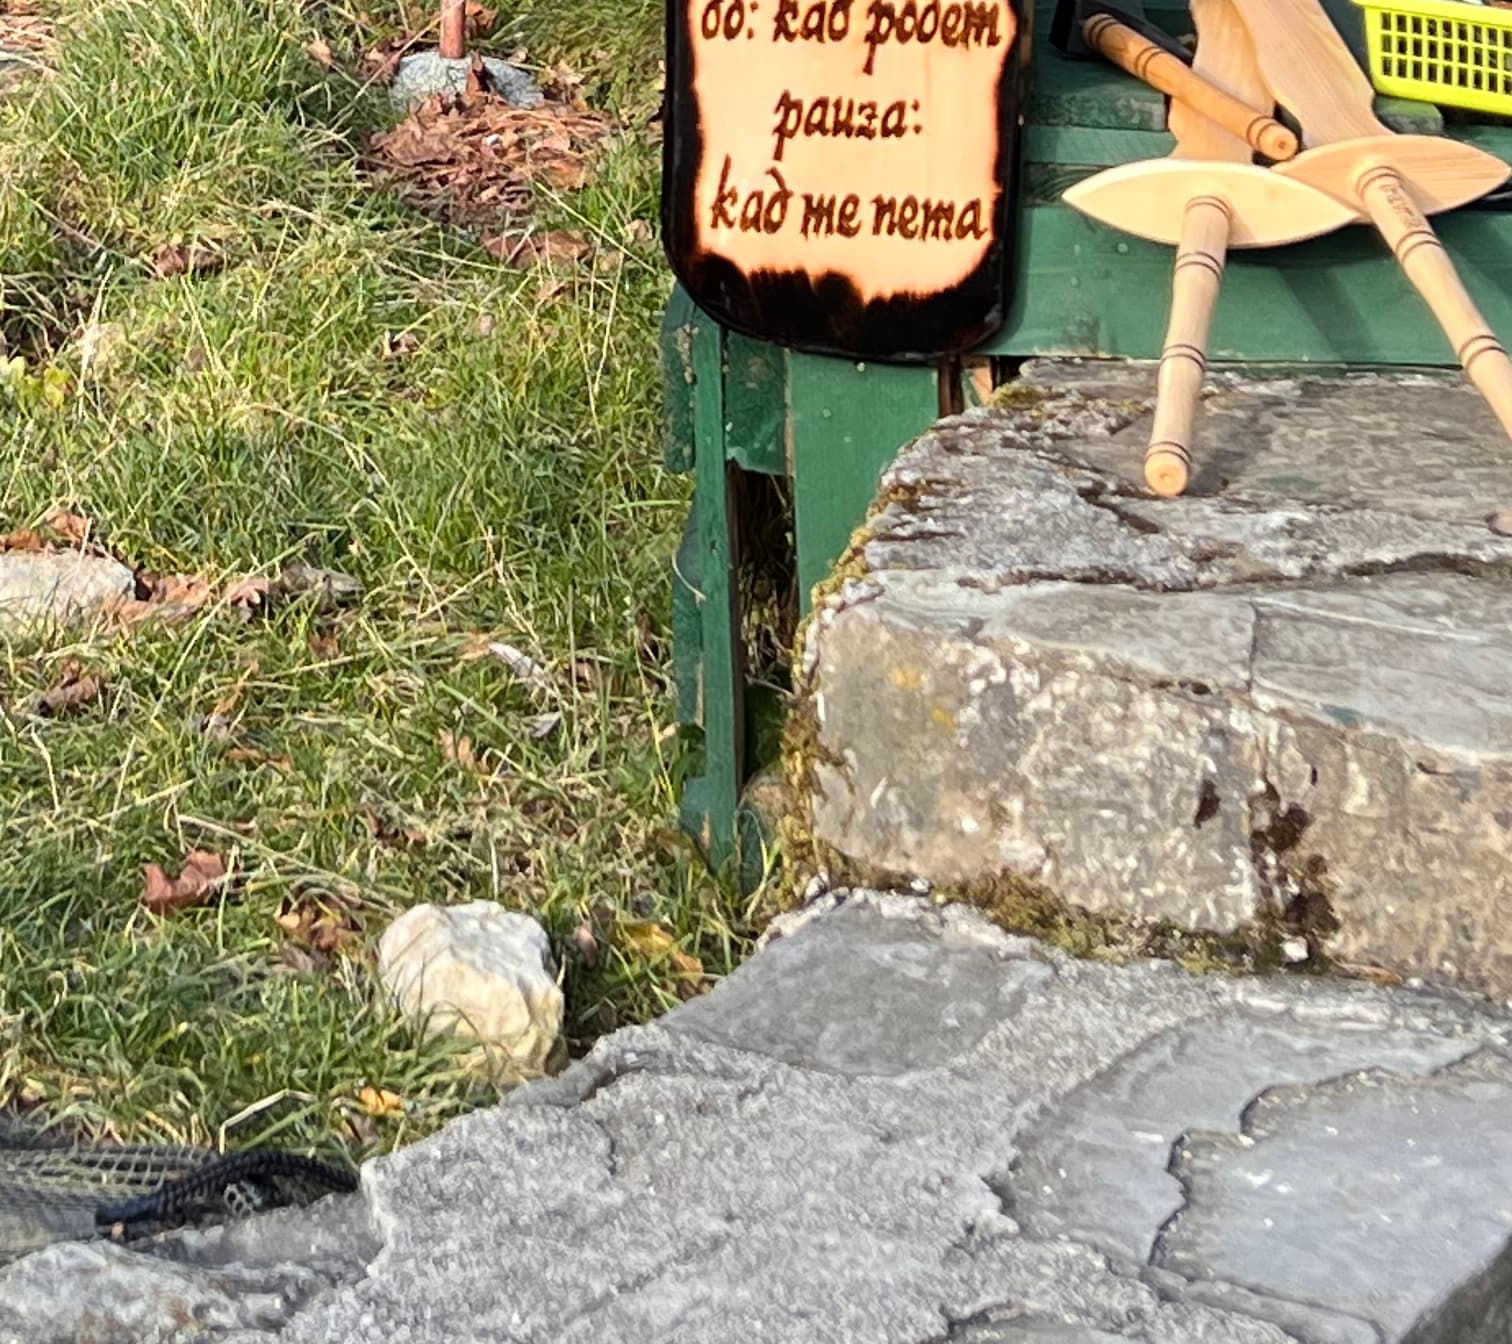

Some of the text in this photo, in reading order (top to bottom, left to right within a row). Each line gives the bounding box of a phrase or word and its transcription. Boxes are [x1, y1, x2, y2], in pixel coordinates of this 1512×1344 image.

[773, 88, 923, 162] pauza:
[709, 153, 989, 242] kad me nema
